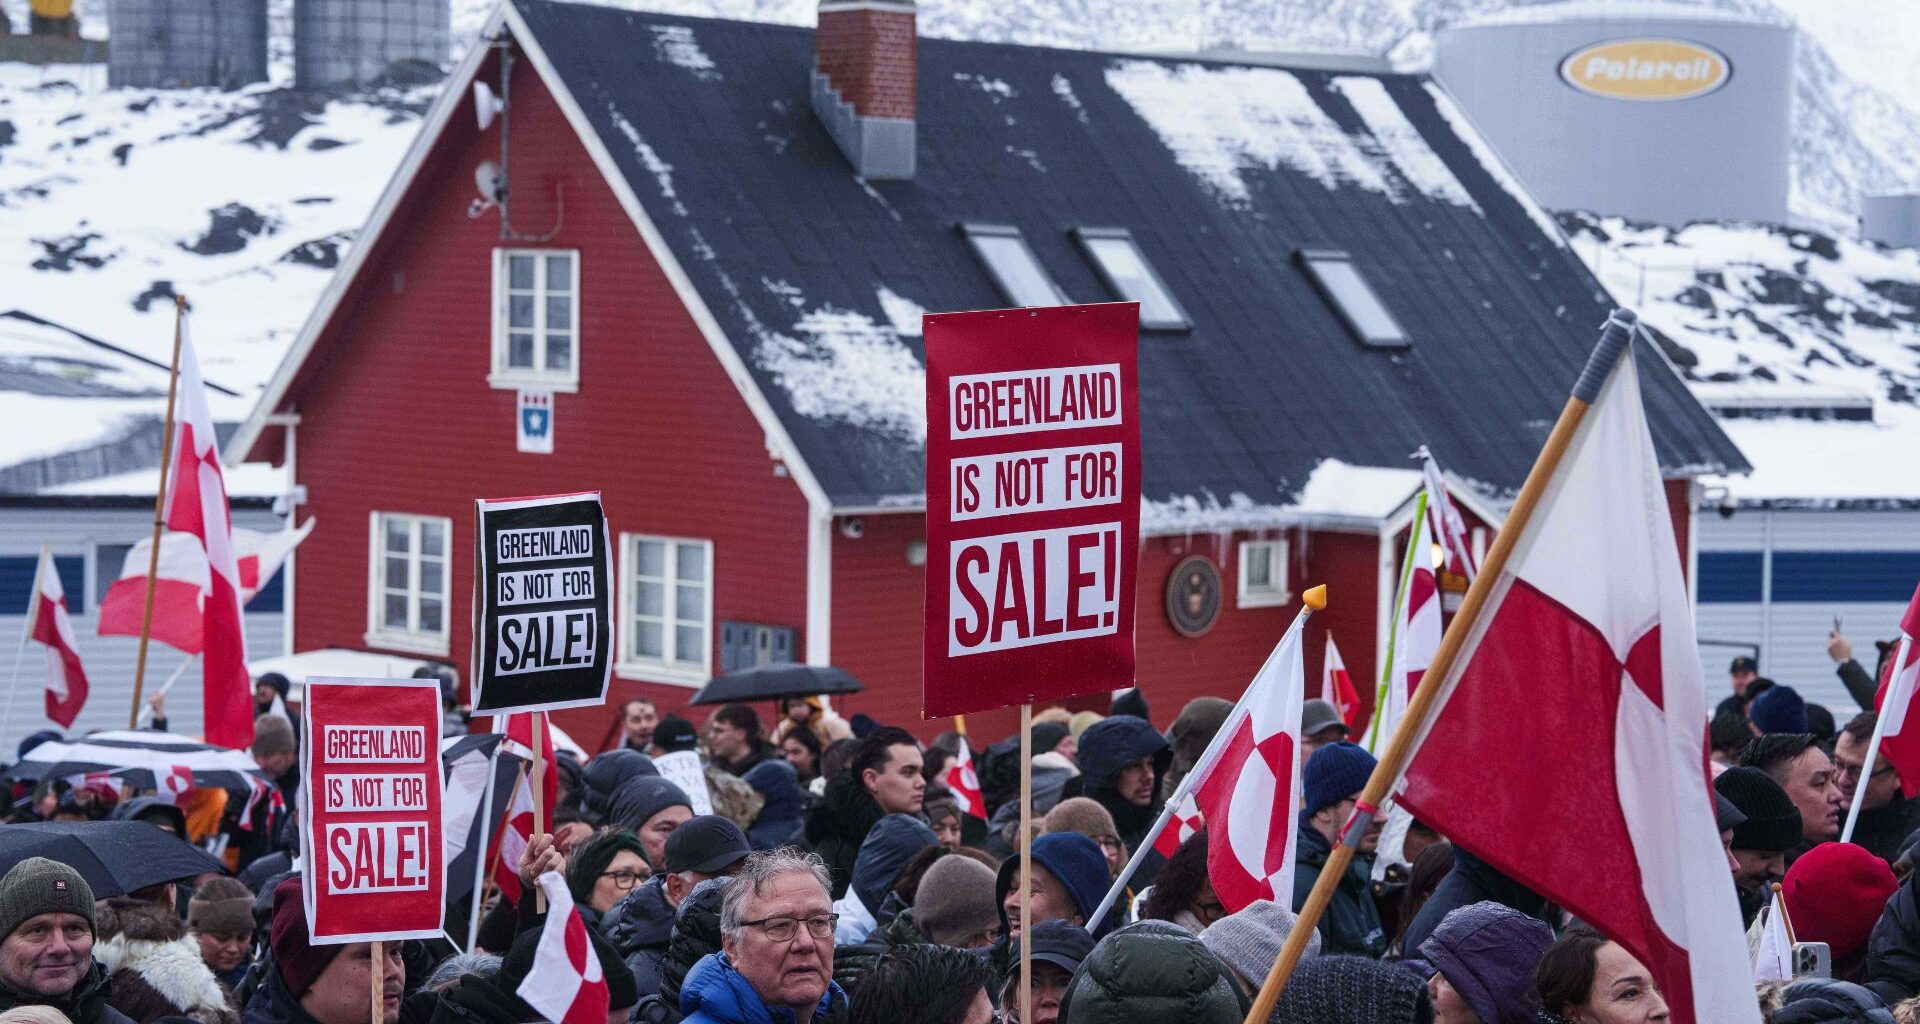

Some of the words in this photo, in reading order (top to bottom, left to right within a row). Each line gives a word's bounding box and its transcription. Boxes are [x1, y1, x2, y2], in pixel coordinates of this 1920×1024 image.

[1584, 56, 1712, 80] Polaroil
[955, 371, 1117, 432] GREENLAND
[956, 464, 980, 514] IS
[995, 457, 1049, 509] NOT
[1065, 451, 1117, 501] FOR
[500, 529, 590, 559] GREENLAND
[500, 576, 515, 602] IS
[524, 573, 554, 600] NOT
[562, 571, 591, 597] FOR
[955, 530, 1117, 648] SALE!
[500, 612, 593, 672] SALE!
[328, 729, 423, 759] GREENLAND
[328, 778, 344, 808] IS
[352, 778, 384, 807] NOT
[393, 778, 424, 807] FOR
[330, 826, 426, 890] SALE!
